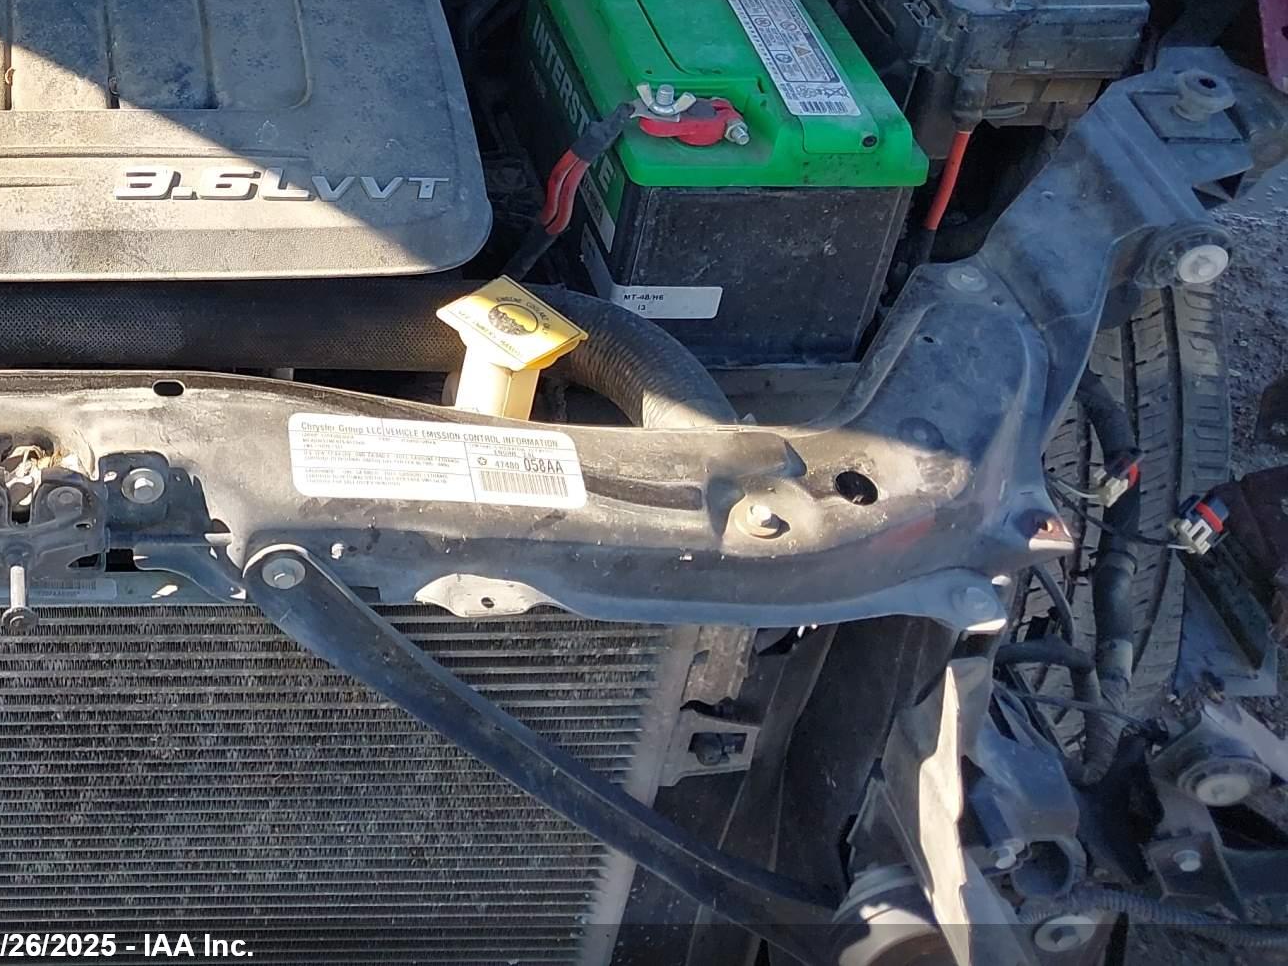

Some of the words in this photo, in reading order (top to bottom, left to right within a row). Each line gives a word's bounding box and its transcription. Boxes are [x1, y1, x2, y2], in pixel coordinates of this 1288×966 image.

[114, 165, 315, 201] 3.6L
[312, 176, 450, 202] VVT
[301, 421, 336, 433] Chrysler
[338, 424, 364, 435] Group
[366, 426, 383, 435] LLC
[385, 426, 419, 437] VEHICLE
[421, 429, 461, 440] EMISSION
[463, 433, 501, 444] CONTROL
[502, 436, 559, 448] INFORMATION
[523, 457, 565, 474] 058AA
